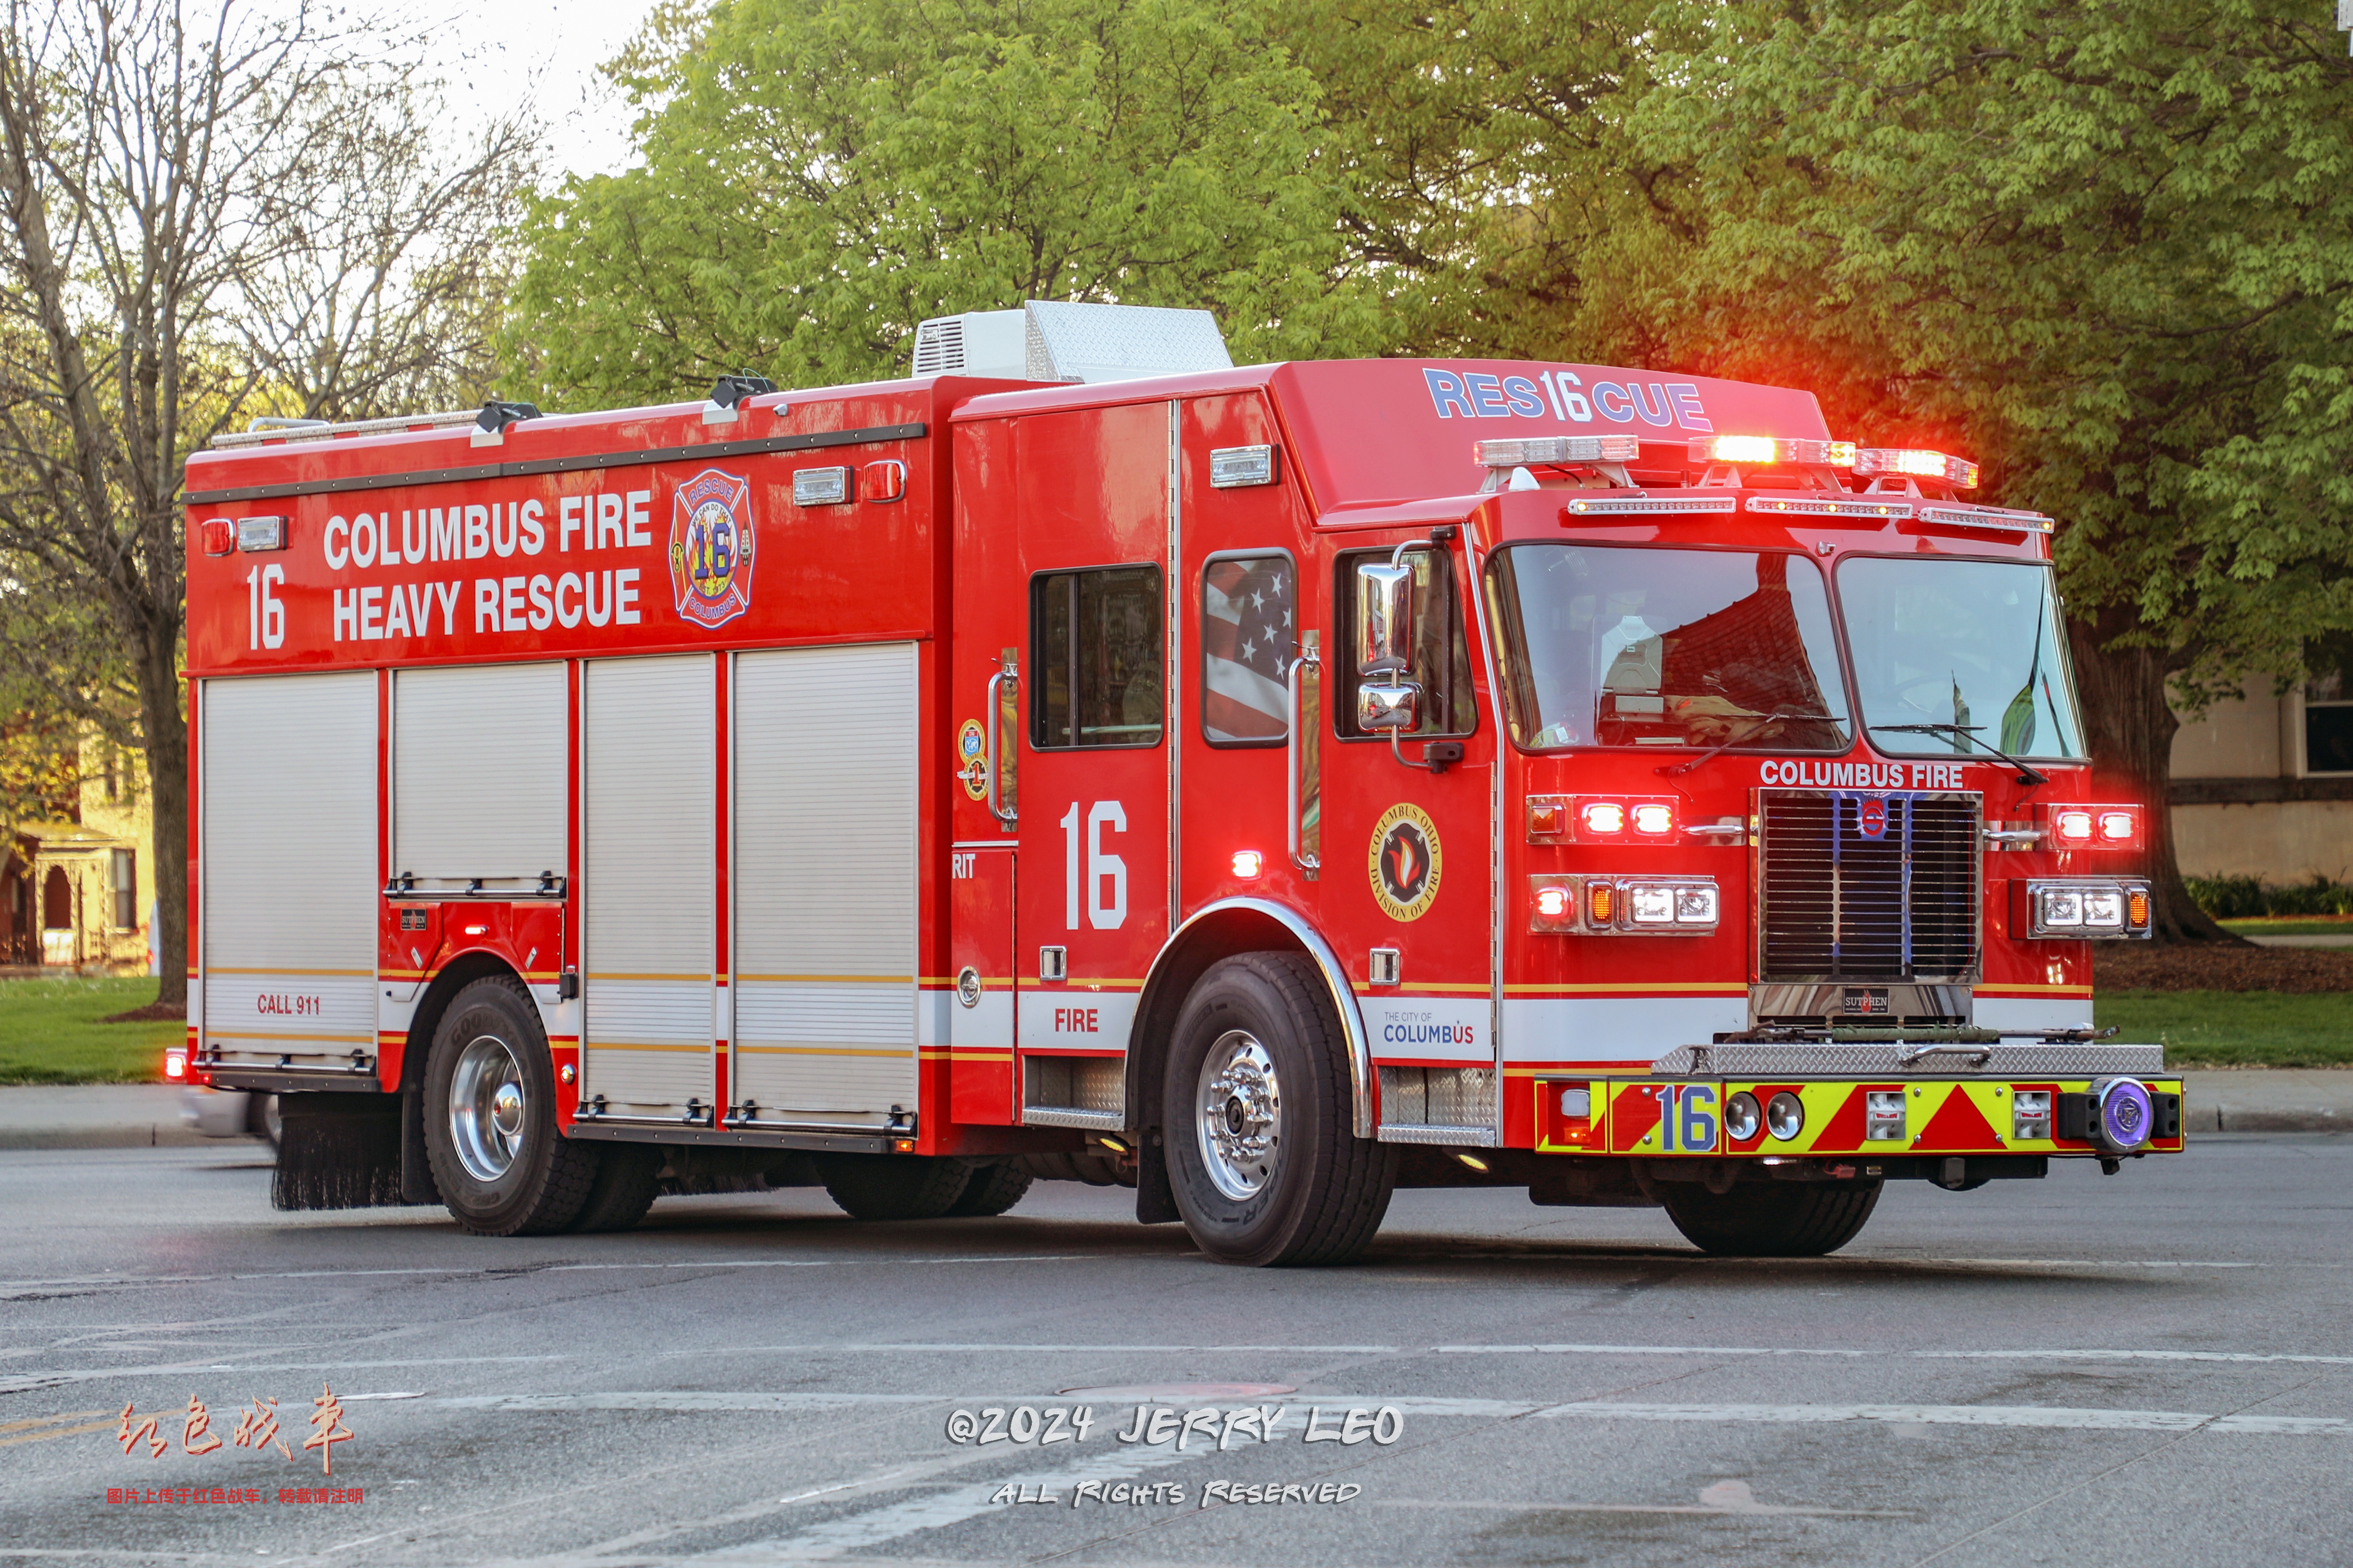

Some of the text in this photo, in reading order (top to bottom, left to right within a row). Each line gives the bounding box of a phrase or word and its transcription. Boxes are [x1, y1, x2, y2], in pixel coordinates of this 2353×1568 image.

[688, 478, 734, 506] RESCUE
[691, 514, 699, 527] WE
[699, 504, 709, 516] CAN
[719, 506, 732, 524] THAT
[324, 490, 651, 571] COLUMBUS FIRE
[695, 523, 730, 580] 16
[699, 581, 725, 594] EST. 1973
[246, 563, 285, 650] 16
[334, 568, 641, 642] HEAVY RESCUE
[689, 593, 736, 620] COLUMBUS
[1760, 760, 1963, 789] COLUMBUS FIRE
[1370, 805, 1439, 856] COLUMBUS OHIO
[952, 853, 976, 879] RIT
[1060, 800, 1127, 930] 16
[1370, 866, 1440, 919] DIVISION OF FIRE
[257, 994, 319, 1015] CALL 911
[1845, 997, 1887, 1007] SUTPHEN
[1054, 1008, 1099, 1032] FIRE
[1384, 1012, 1432, 1022] THE CITY OF
[1384, 1024, 1474, 1044] COLUMBUS
[1655, 1085, 1717, 1151] 16
